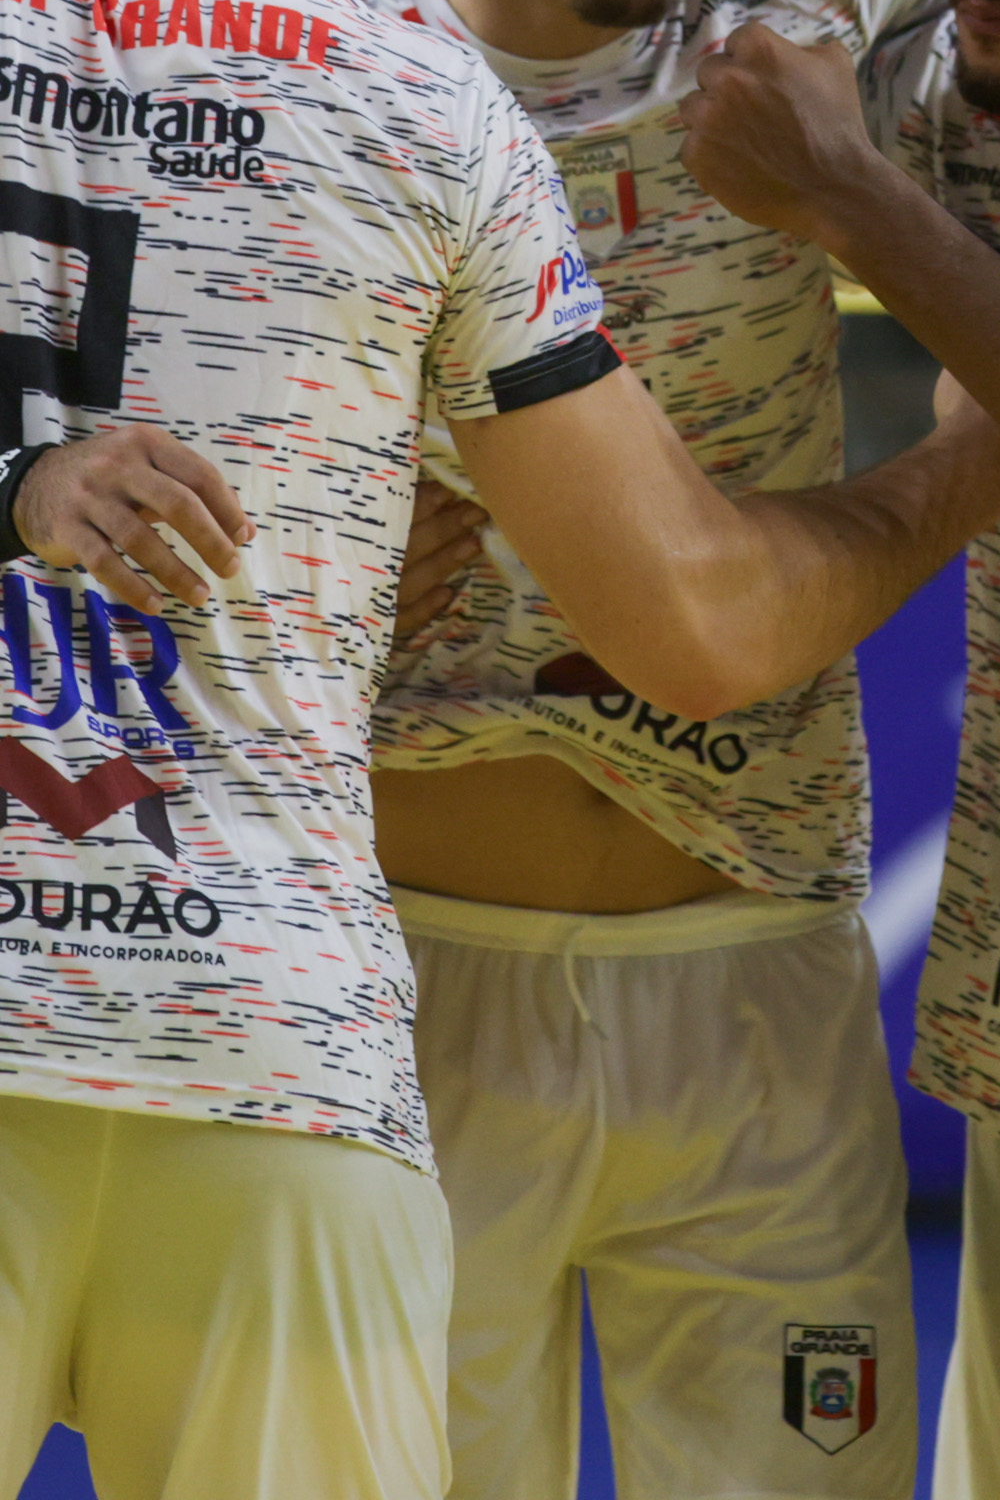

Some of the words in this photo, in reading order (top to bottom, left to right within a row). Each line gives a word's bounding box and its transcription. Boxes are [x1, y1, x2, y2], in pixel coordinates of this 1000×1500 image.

[52, 941, 62, 955] E
[69, 943, 226, 967] INCORPORADORA
[803, 1329, 859, 1341] PRAIA
[791, 1342, 870, 1357] GRANDE
